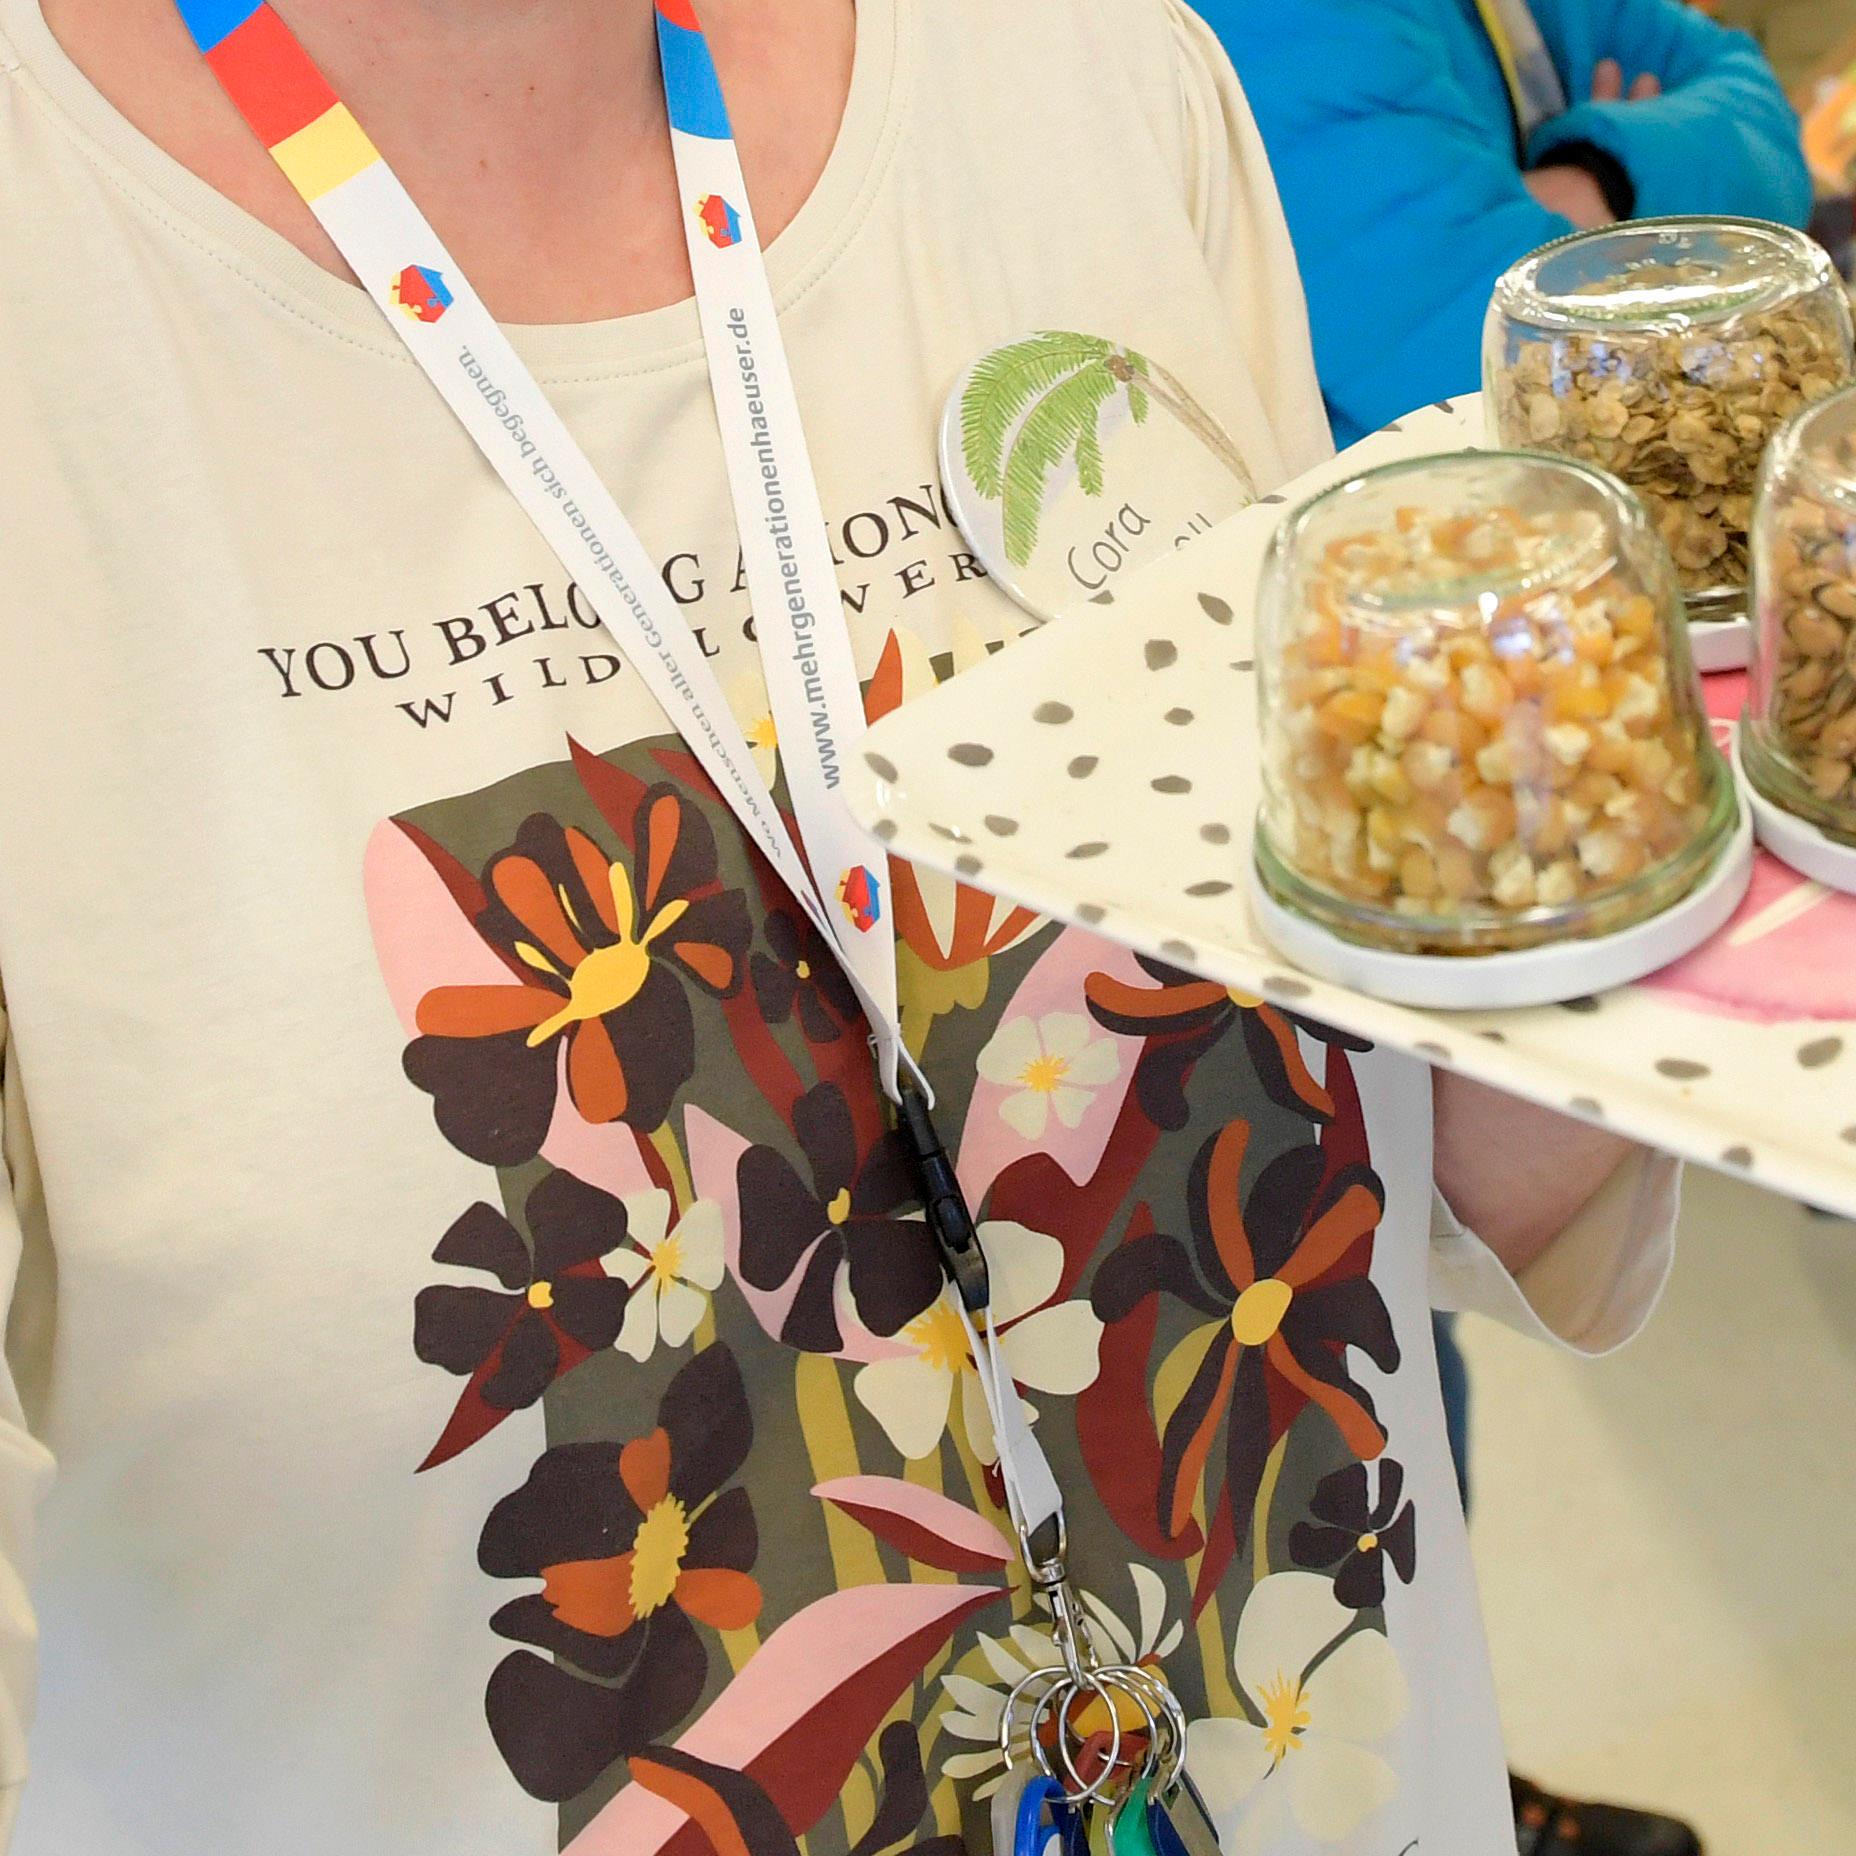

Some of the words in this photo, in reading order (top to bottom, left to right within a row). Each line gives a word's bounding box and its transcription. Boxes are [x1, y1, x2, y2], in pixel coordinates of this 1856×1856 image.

[456, 344, 538, 460] begegnen.
[530, 454, 568, 501] sich
[561, 498, 663, 650] Generationen
[726, 306, 841, 792] www.mehrgenerationenhaeuser.de
[1066, 501, 1152, 591] Cora
[257, 629, 412, 698] YOU
[431, 552, 706, 667] BELOG
[657, 650, 696, 702] aller
[692, 703, 760, 817] Menschen
